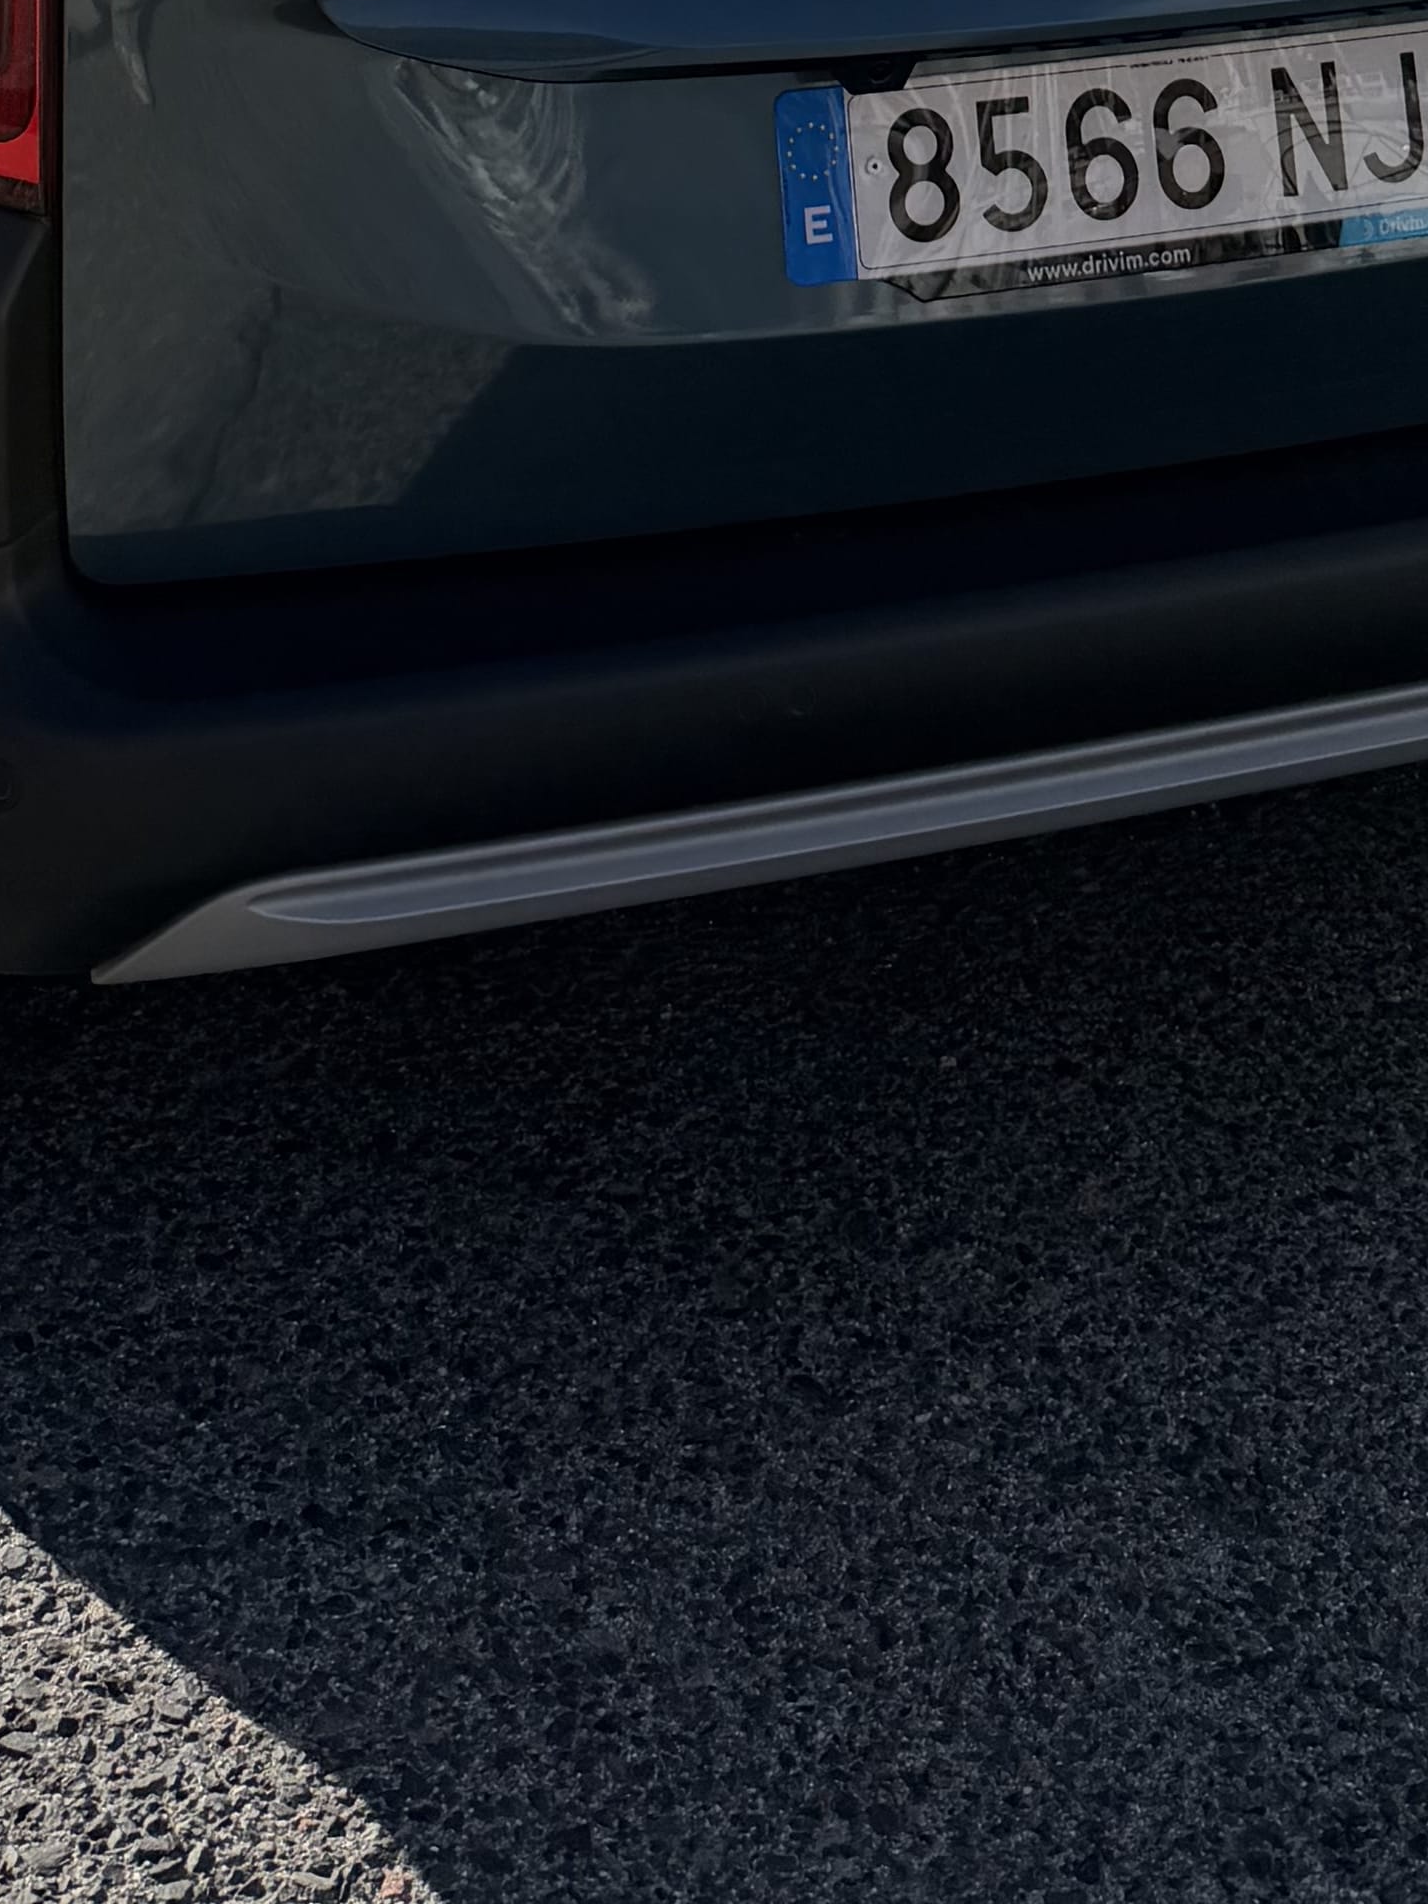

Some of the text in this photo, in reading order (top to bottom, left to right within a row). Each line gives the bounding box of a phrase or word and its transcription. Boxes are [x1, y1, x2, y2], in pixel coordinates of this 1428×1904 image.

[804, 205, 833, 245] E
[887, 78, 1225, 242] 8566
[1028, 248, 1192, 282] www.drivim.com
